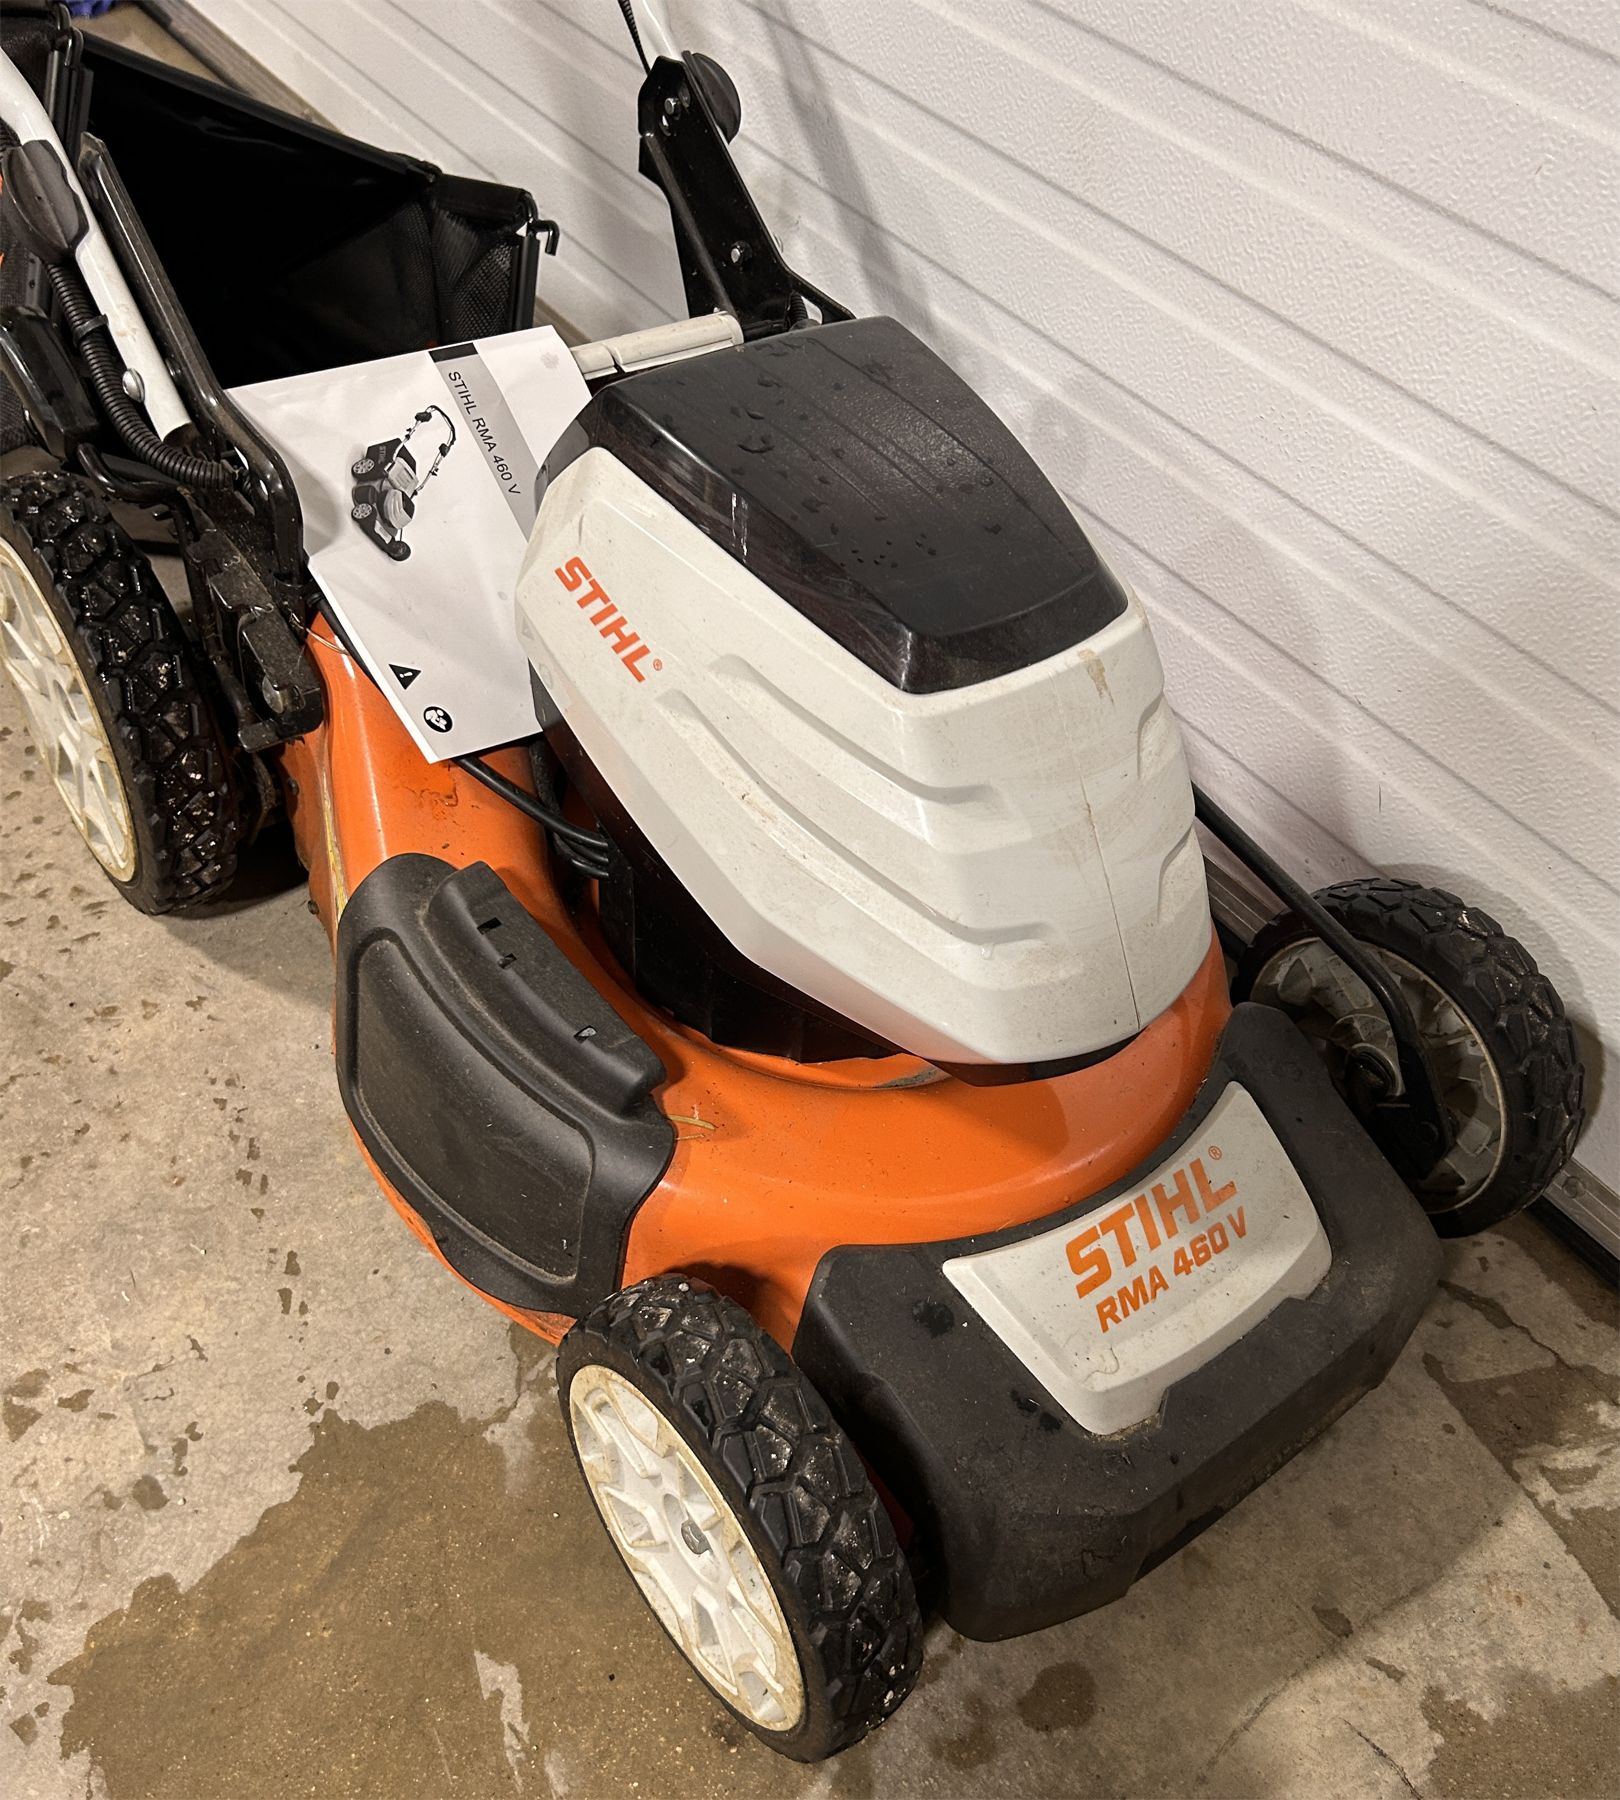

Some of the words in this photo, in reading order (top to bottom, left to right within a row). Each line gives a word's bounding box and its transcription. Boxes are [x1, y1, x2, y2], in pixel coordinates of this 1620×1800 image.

[448, 371, 477, 415] STIHL
[472, 417, 497, 452] RMA
[493, 455, 513, 481] 460
[508, 483, 521, 495] V
[1096, 1264, 1169, 1333] RMA
[1173, 1222, 1229, 1277] 460
[1227, 1205, 1247, 1239] V
